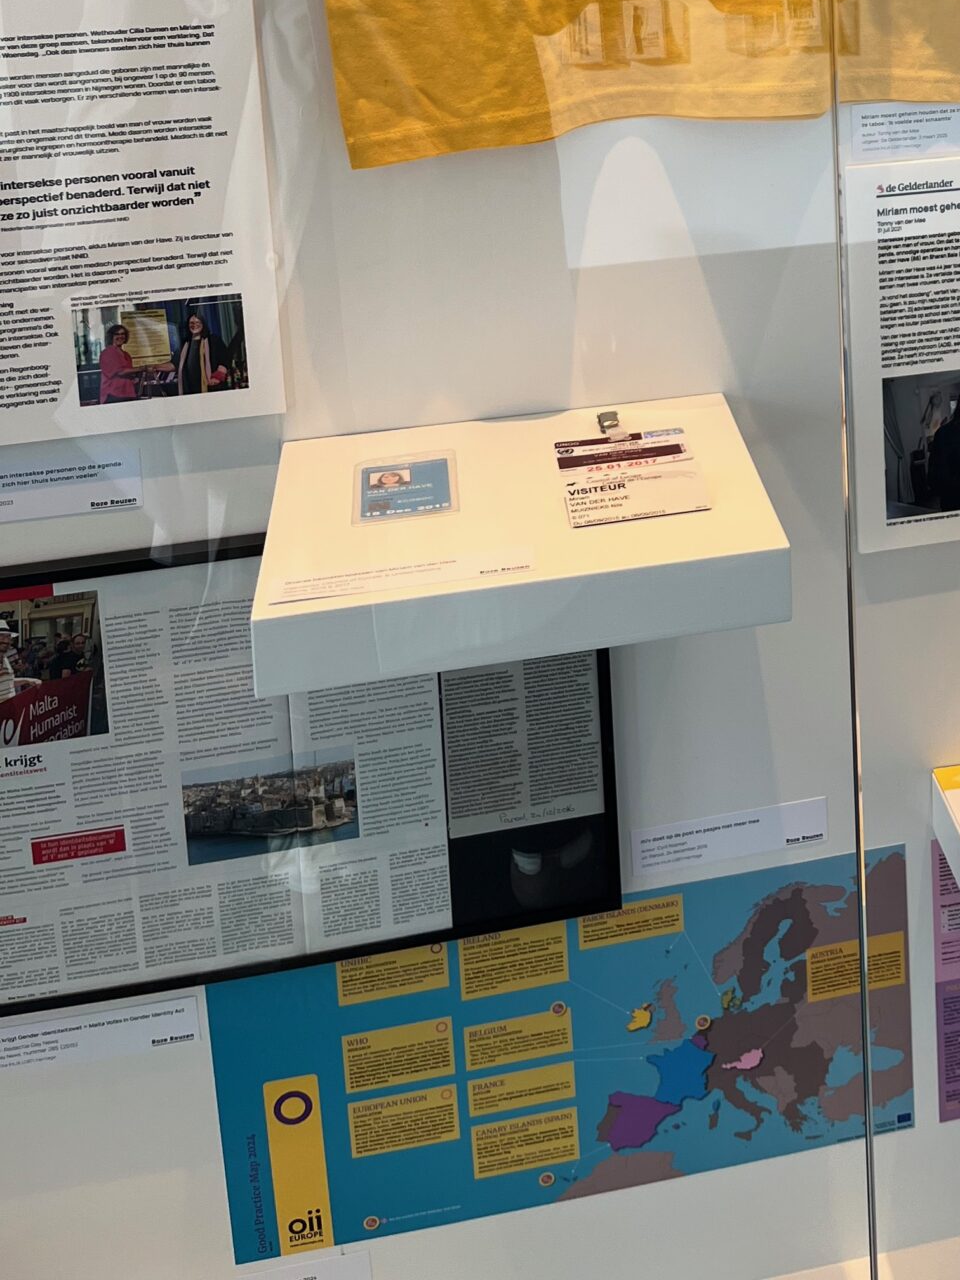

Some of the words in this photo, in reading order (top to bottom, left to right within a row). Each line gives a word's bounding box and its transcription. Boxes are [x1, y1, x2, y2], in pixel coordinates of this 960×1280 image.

[0, 178, 63, 191] intersekse
[64, 174, 120, 188] personen
[121, 168, 158, 181] vooral
[158, 166, 196, 178] vanuit
[885, 184, 897, 193] de
[897, 179, 954, 192] Gelderlander
[65, 186, 125, 201] benaderd.
[126, 183, 165, 195] Terwijl
[166, 182, 186, 192] dat
[187, 180, 211, 194] niet
[0, 213, 15, 222] ze
[15, 211, 31, 220] zo
[31, 207, 59, 221] juist
[60, 200, 150, 216] onzichtbaarder
[877, 207, 908, 217] Miriam
[909, 203, 938, 214] moest
[567, 482, 626, 496] VISITEUR
[110, 497, 137, 505] Reuzen
[29, 694, 59, 720] Malta
[30, 704, 78, 741] Humanist
[4, 754, 43, 768] krijgt
[169, 1033, 195, 1042] Reuzen
[346, 1036, 369, 1047] WHO
[468, 1025, 508, 1040] BELGIUM
[472, 1079, 505, 1093] FRANCE
[352, 1099, 399, 1115] EUROPEAN
[399, 1094, 428, 1106] UNION
[246, 1133, 257, 1159] 2024
[249, 1160, 260, 1184] Map
[252, 1185, 265, 1226] Practice
[288, 1208, 323, 1235] oii
[255, 1227, 267, 1254] Good
[289, 1230, 324, 1243] EUROPE
